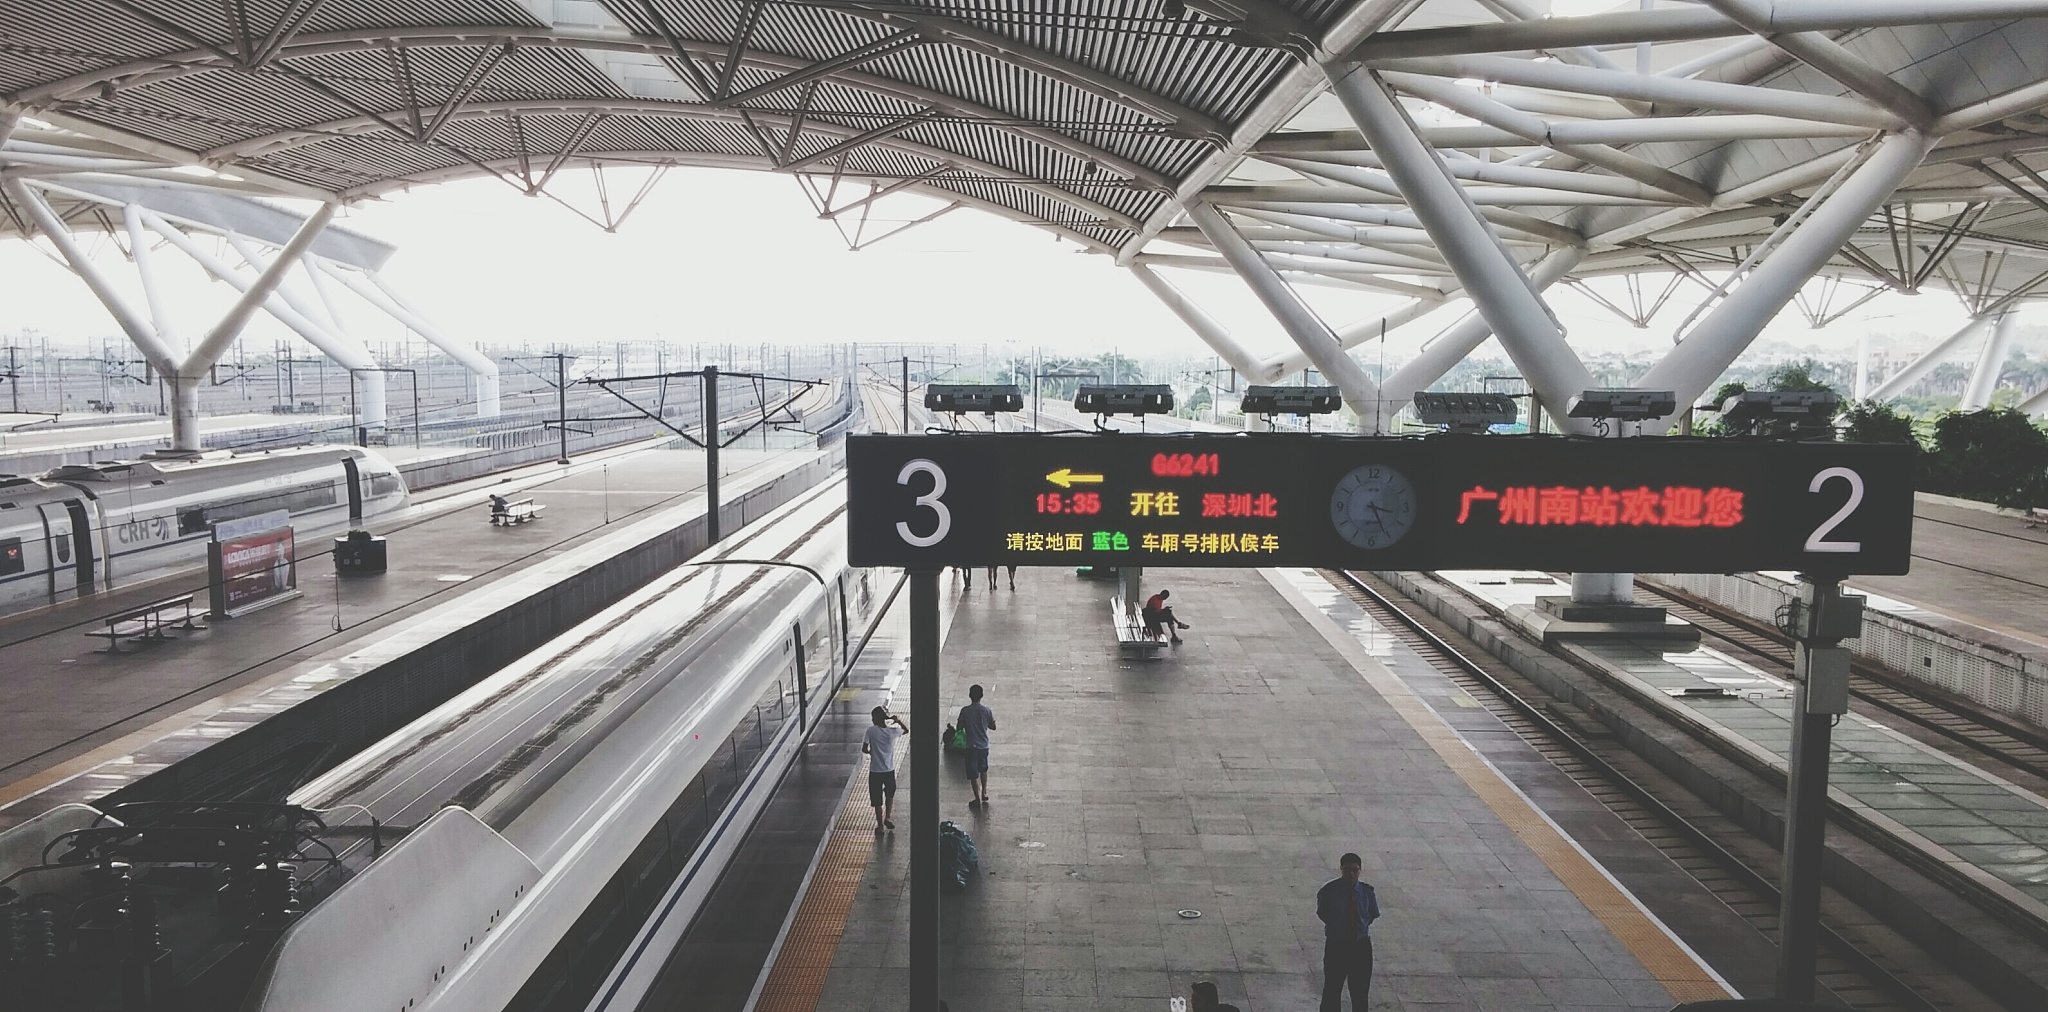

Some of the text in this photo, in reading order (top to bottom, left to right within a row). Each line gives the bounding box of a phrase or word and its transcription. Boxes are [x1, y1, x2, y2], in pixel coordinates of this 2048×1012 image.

[1151, 453, 1219, 477] G6241
[1368, 468, 1380, 479] 12
[895, 458, 951, 548] 3
[1036, 492, 1278, 518] 15:35 开往 深圳北
[1336, 501, 1344, 513] 9
[1402, 502, 1409, 514] 3
[1457, 485, 1744, 527] 广州南站欢迎您
[1803, 466, 1864, 553] 2
[118, 521, 149, 544] CRH
[1005, 531, 1280, 554] 请按地面 蓝色 车厢号排队候车
[1367, 536, 1376, 547] 6
